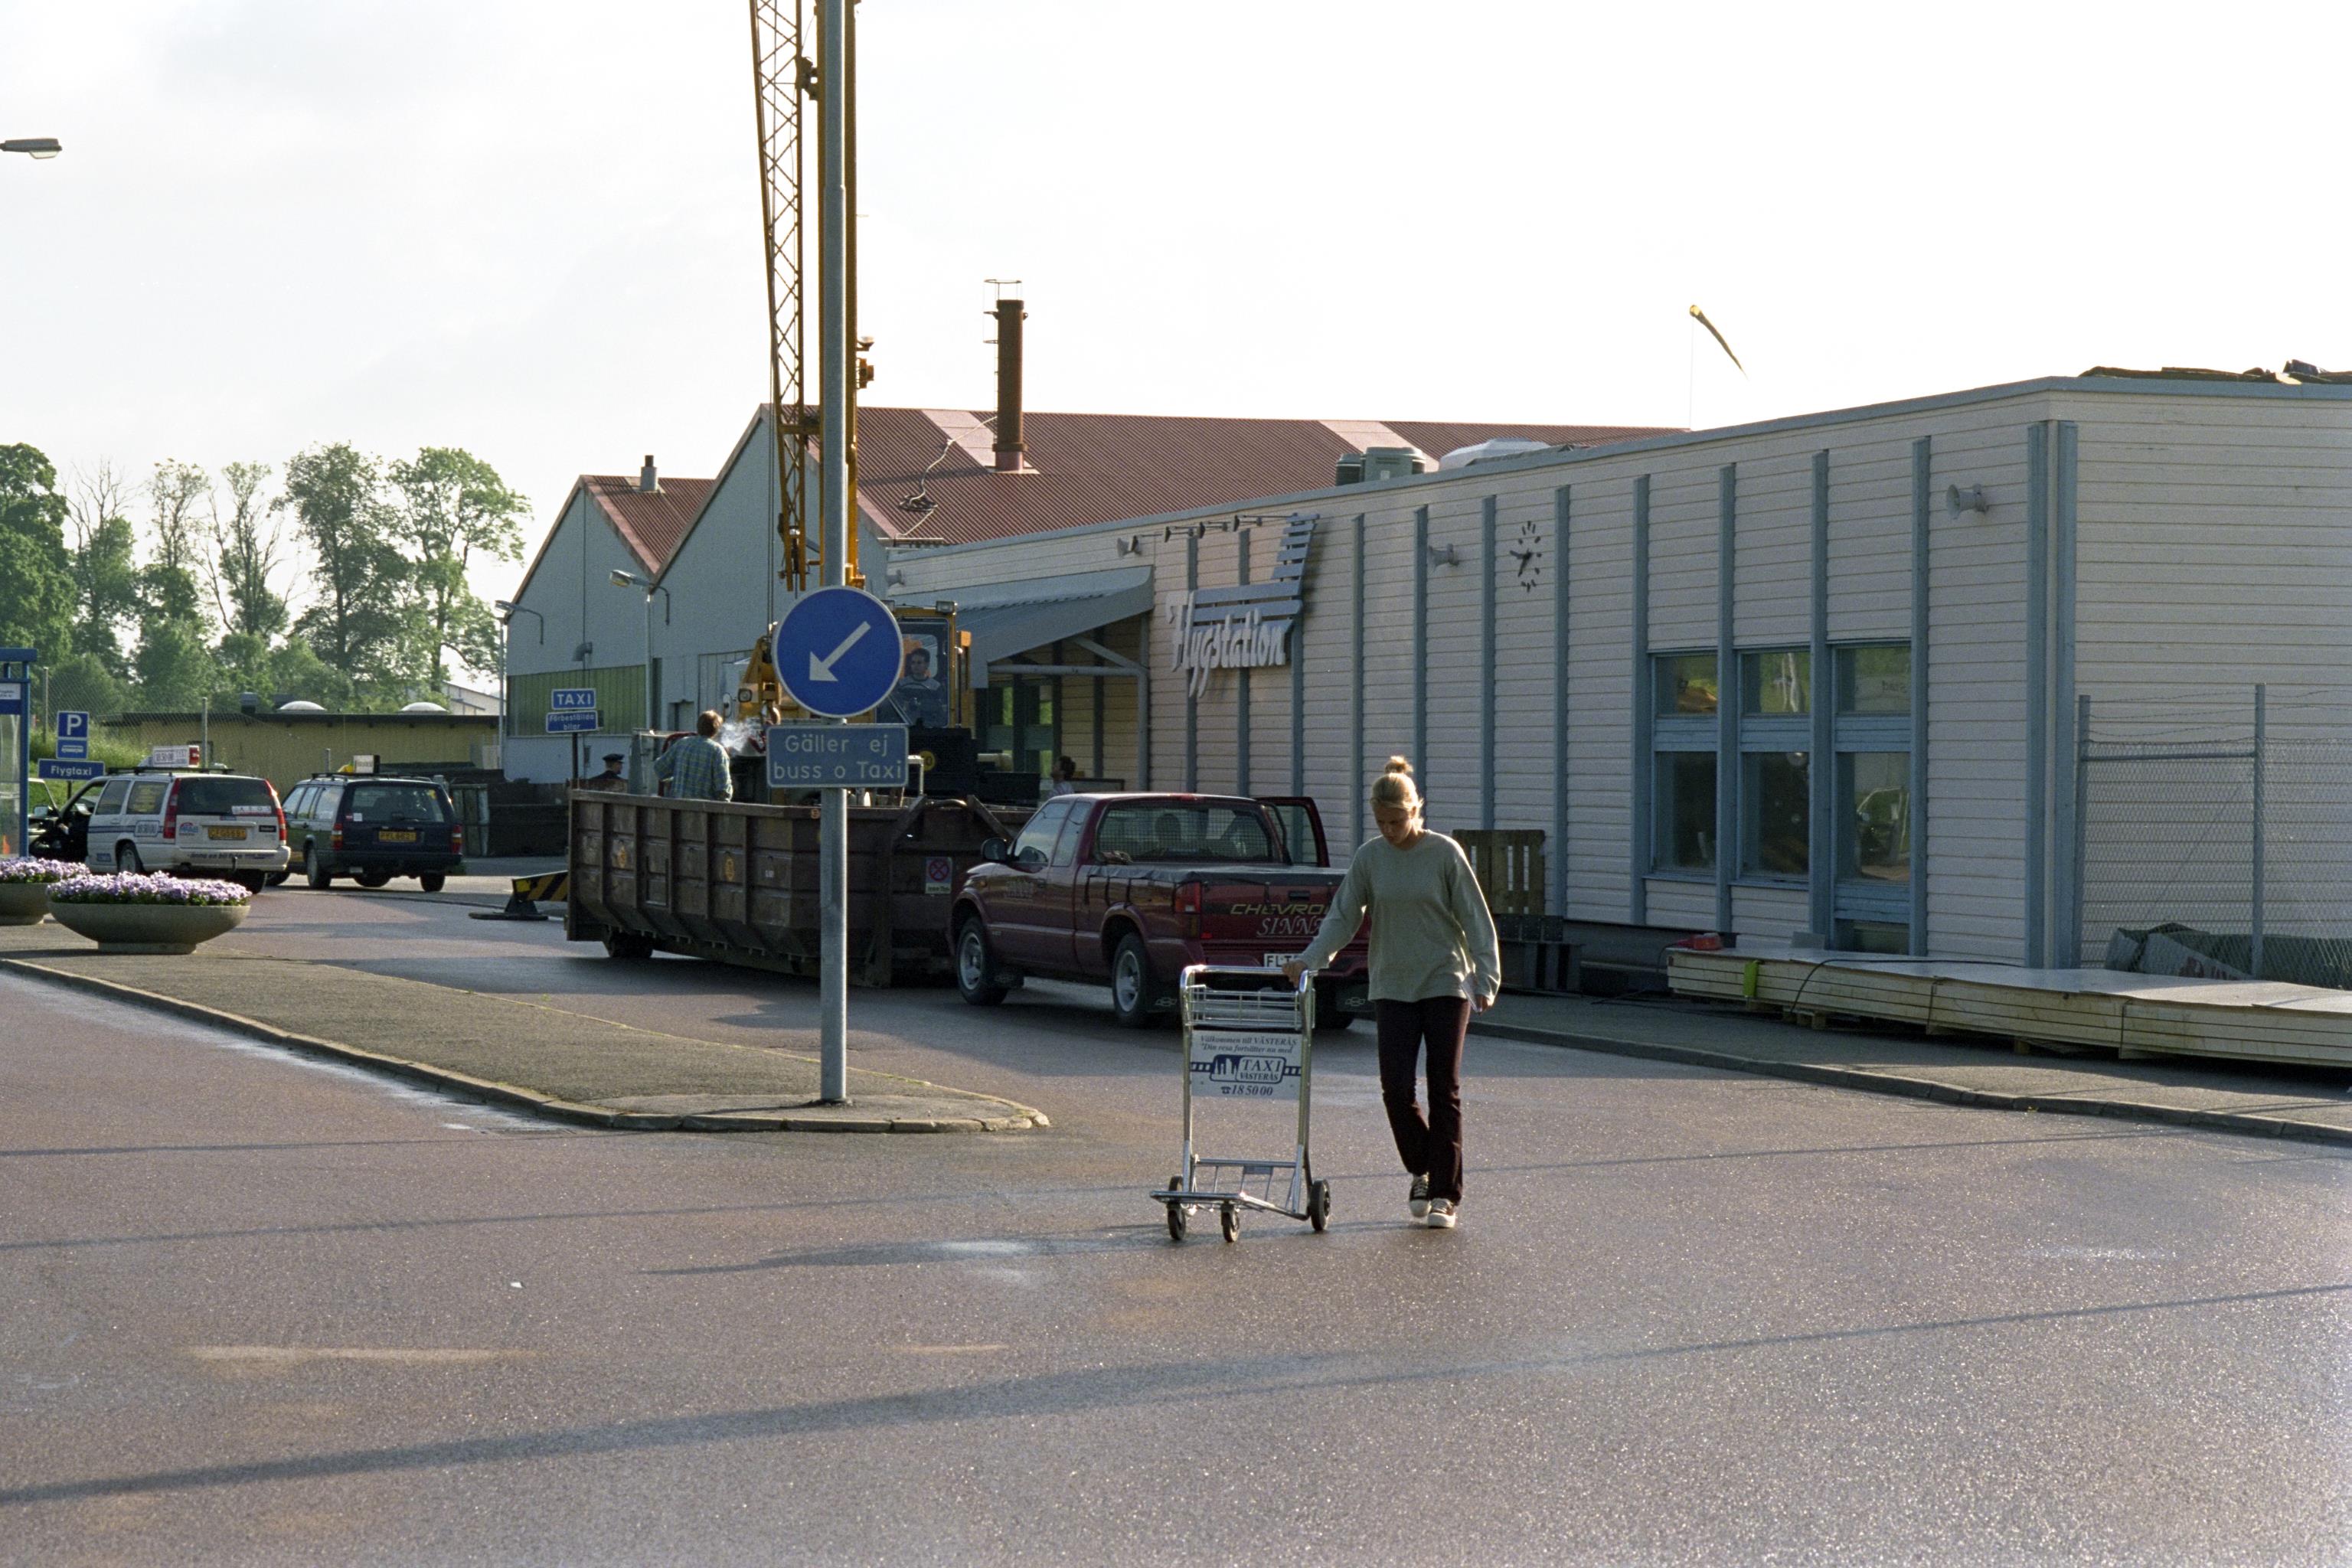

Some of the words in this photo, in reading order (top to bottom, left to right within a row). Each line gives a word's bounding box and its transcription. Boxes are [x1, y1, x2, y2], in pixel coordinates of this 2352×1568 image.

[1166, 590, 1286, 698] Flygstation
[557, 693, 592, 705] TAXI
[67, 714, 82, 736] P
[785, 733, 850, 753] Gäller
[869, 734, 889, 756] ej
[51, 765, 93, 776] Flygtaxi
[773, 761, 822, 779] buss
[834, 766, 846, 779] o
[856, 760, 902, 779] Taxi
[1200, 1035, 1241, 1044] Välkommen
[1253, 1035, 1297, 1047] VÄSTERÅS
[1242, 1059, 1282, 1072] TAXI
[1240, 1071, 1279, 1081] VÄSTERÅS
